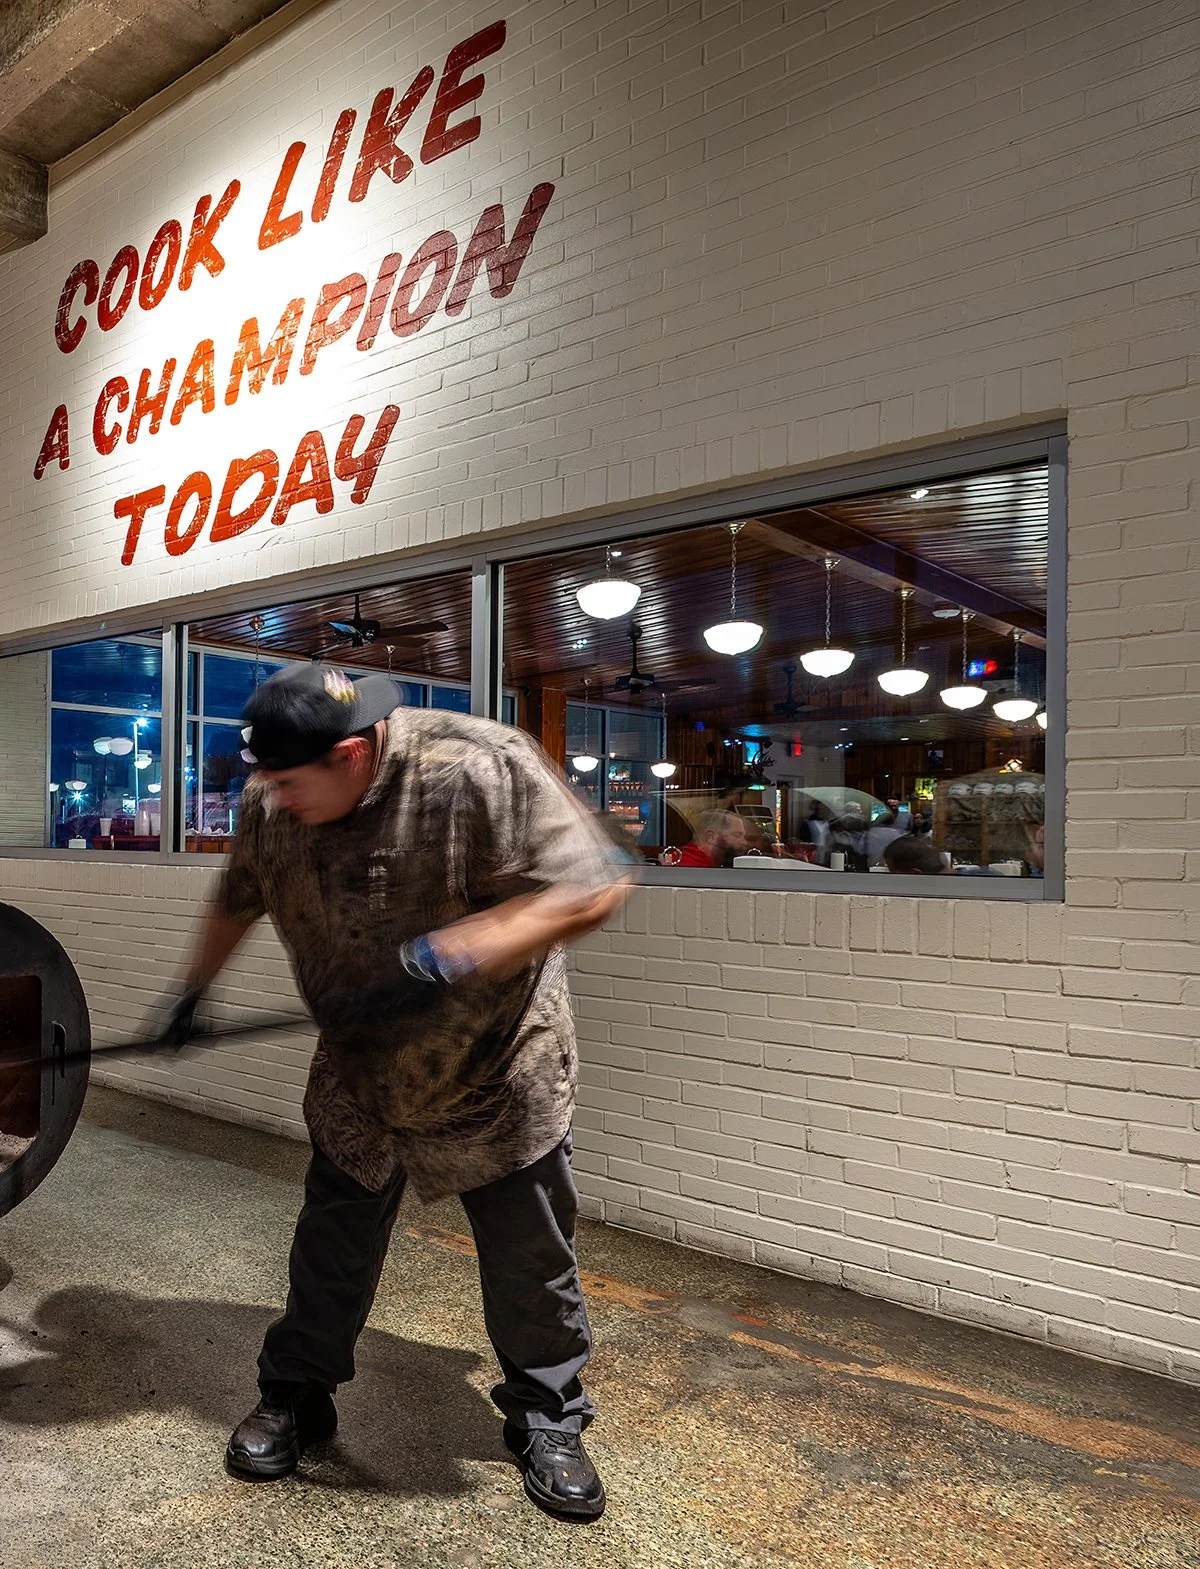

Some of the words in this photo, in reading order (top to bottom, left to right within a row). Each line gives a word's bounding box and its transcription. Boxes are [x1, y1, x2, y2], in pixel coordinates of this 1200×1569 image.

[33, 404, 70, 480] A
[91, 181, 556, 456] CHAMPION
[54, 178, 242, 354] COOK
[257, 19, 507, 251] LIKE
[114, 404, 401, 566] TODAY
